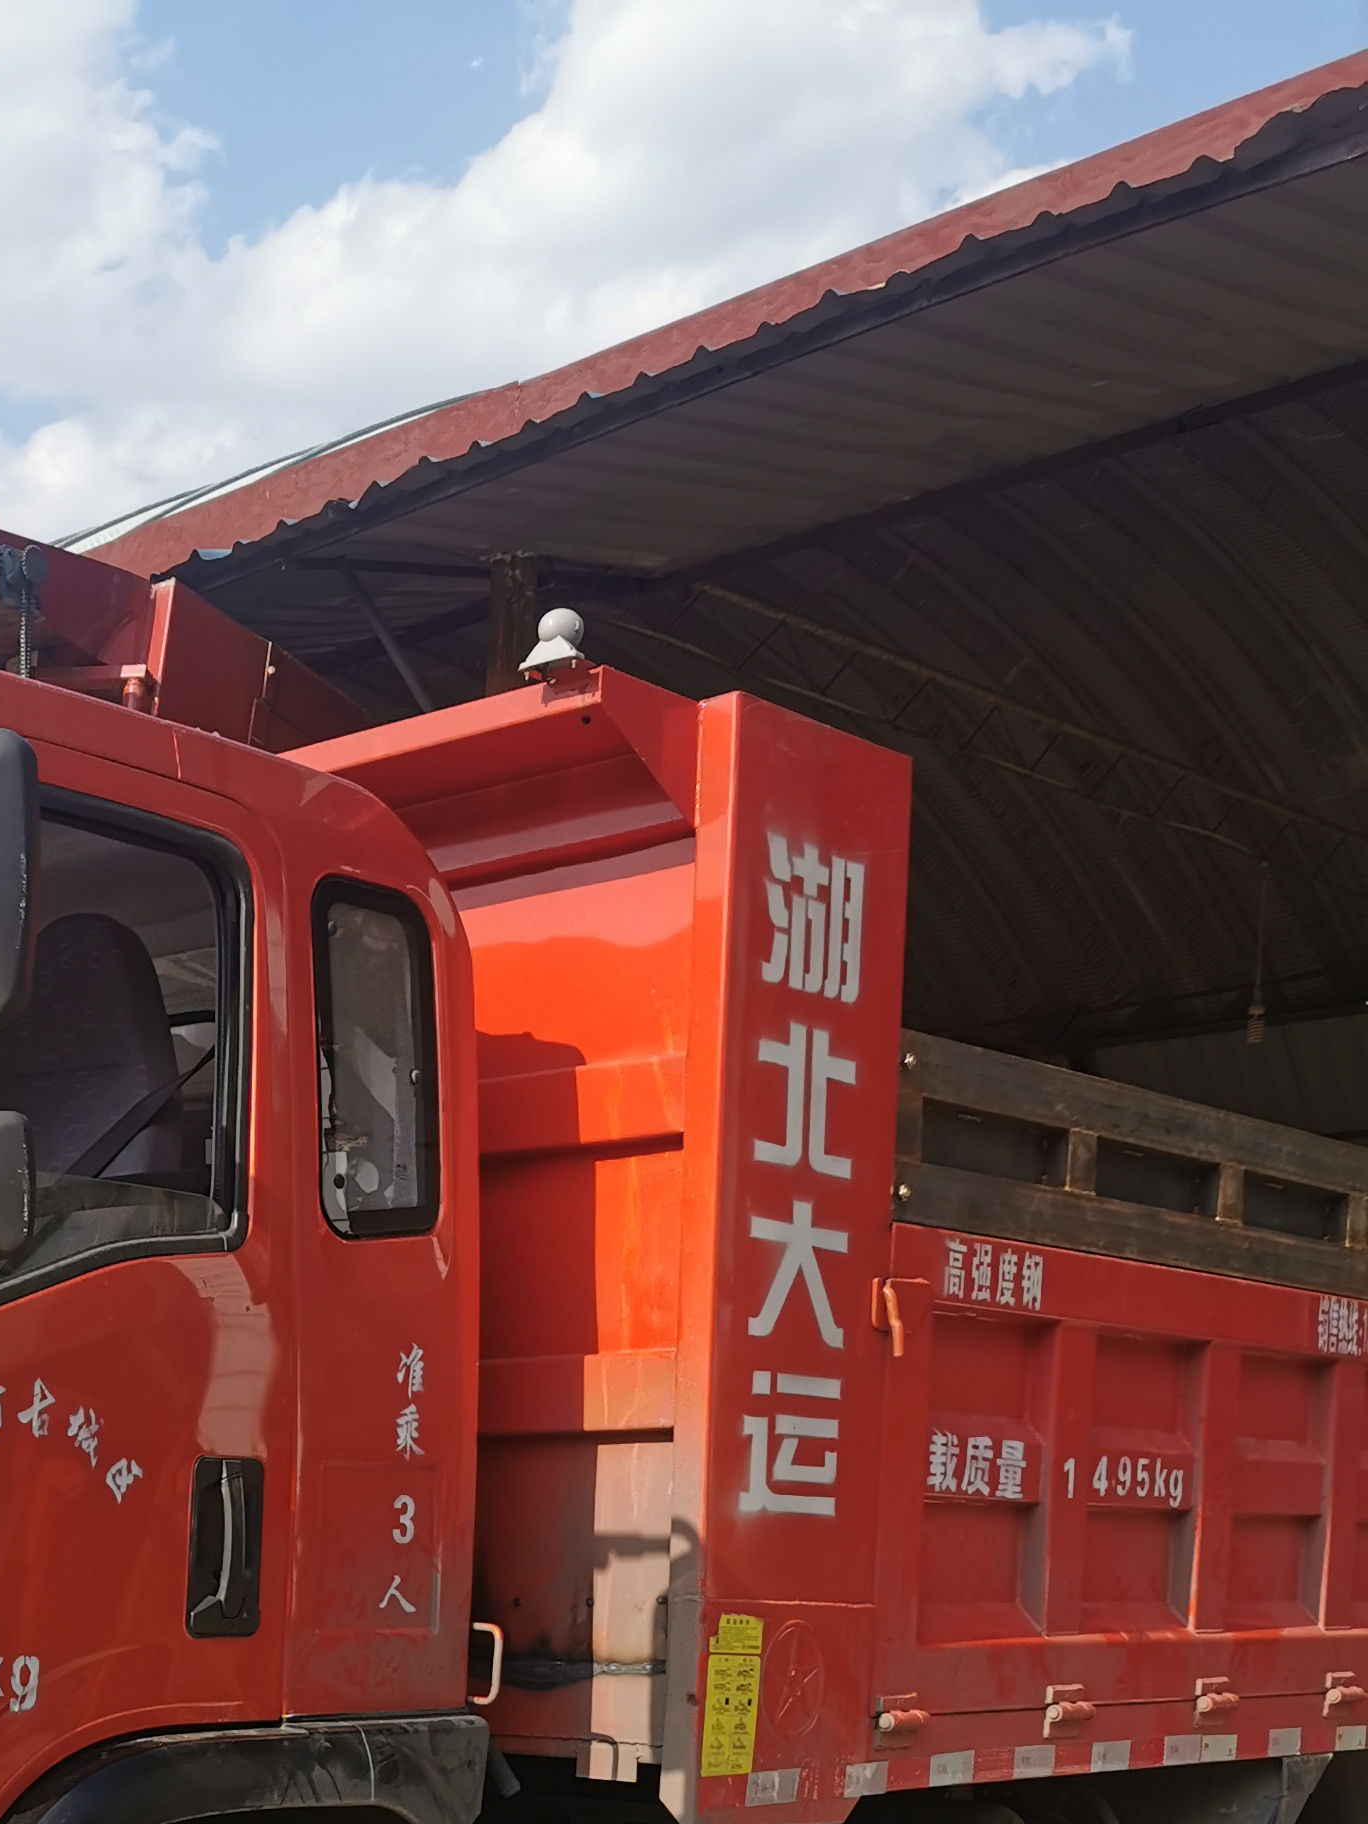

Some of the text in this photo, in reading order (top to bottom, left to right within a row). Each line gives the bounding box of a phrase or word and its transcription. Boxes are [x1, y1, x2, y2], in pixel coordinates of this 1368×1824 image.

[739, 829, 865, 1517] 湖北大运
[942, 1238, 1043, 1312] 高强度钢
